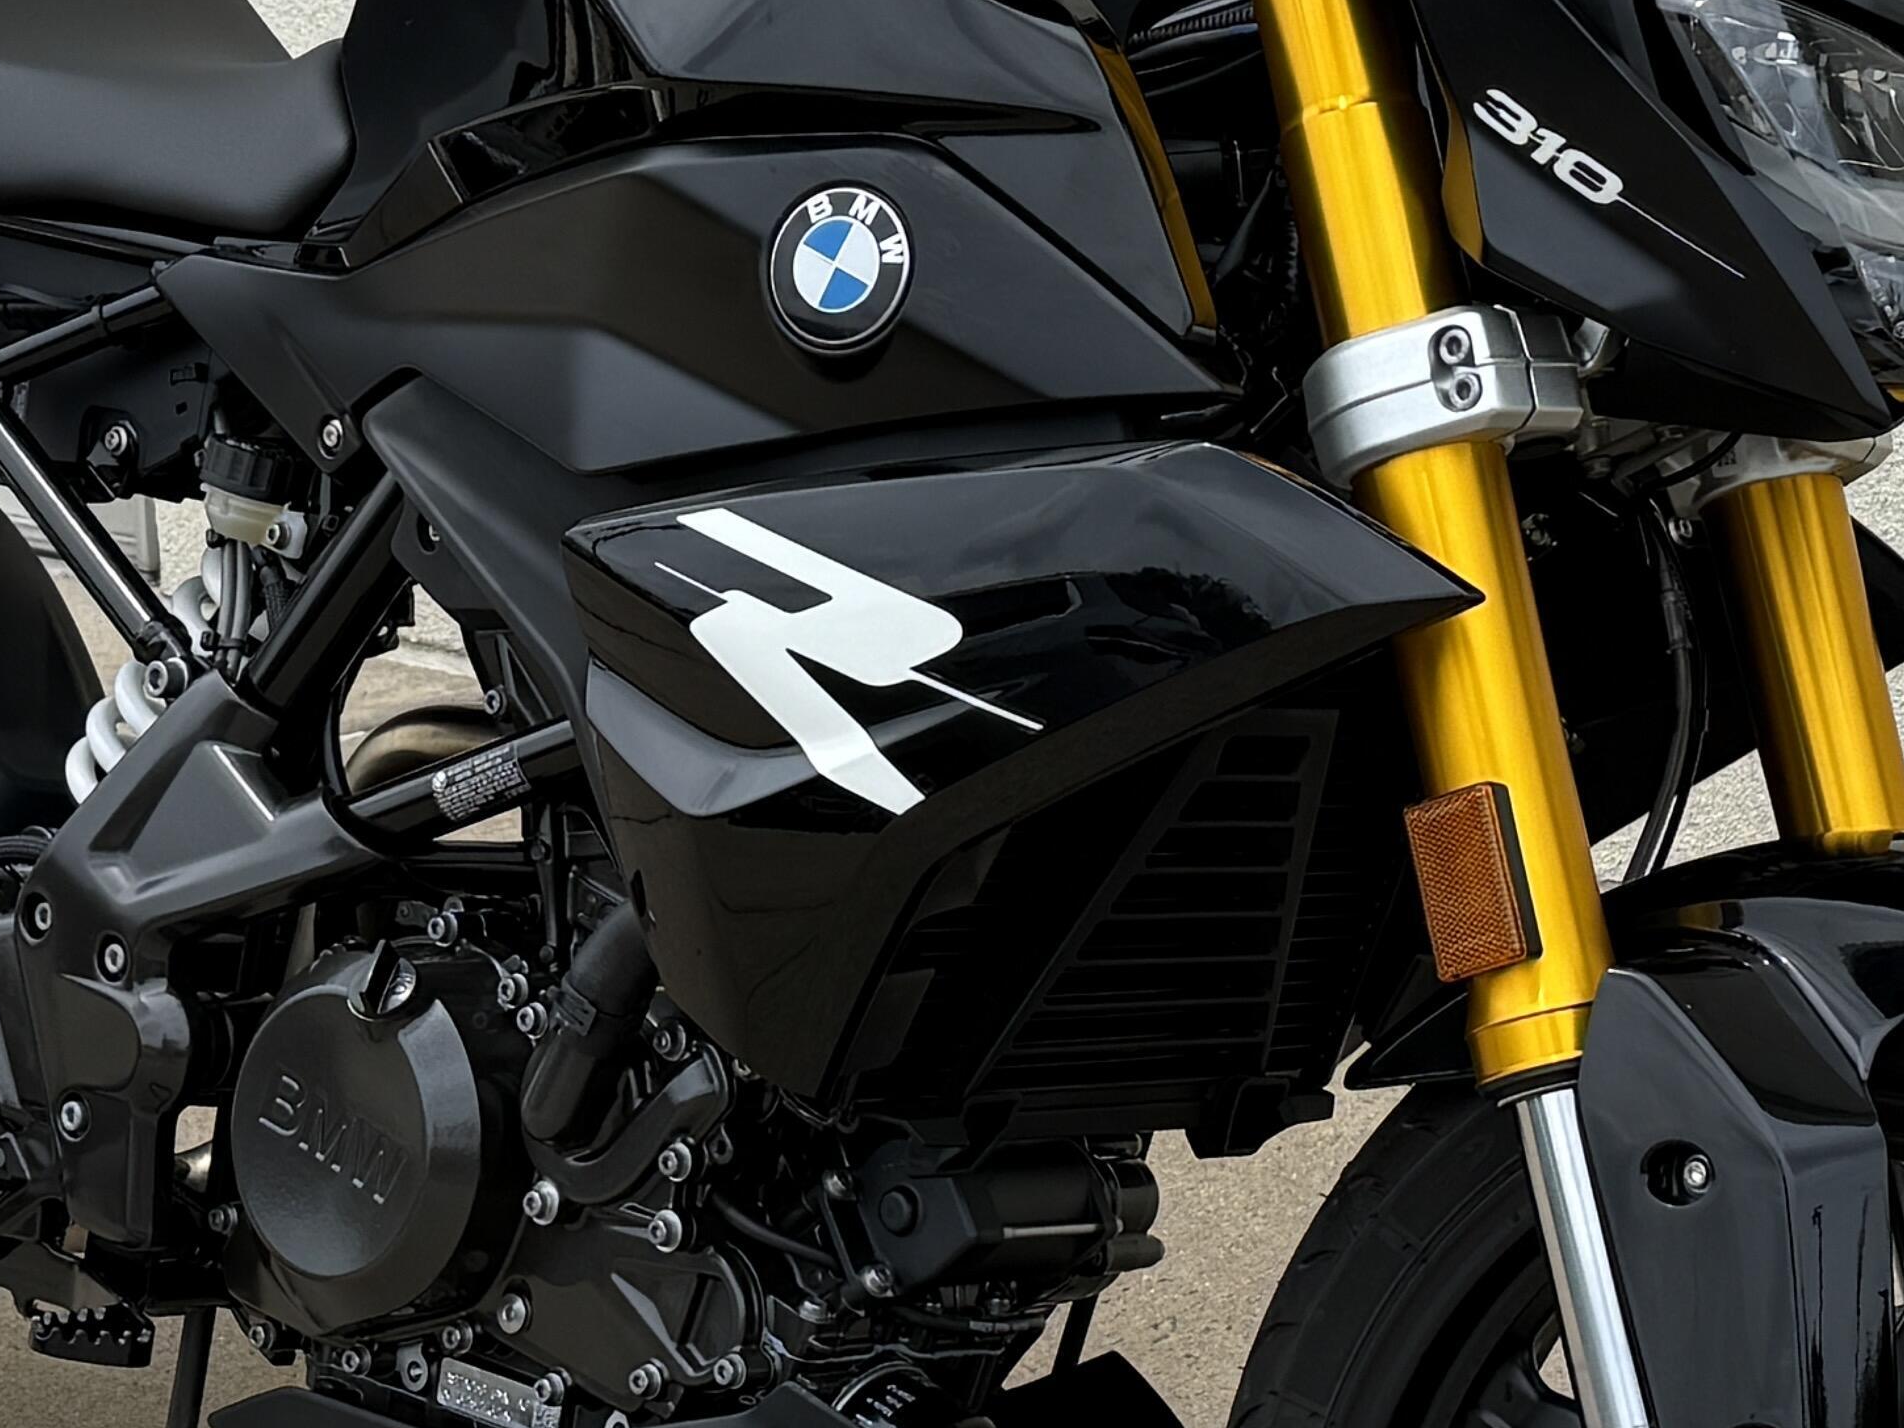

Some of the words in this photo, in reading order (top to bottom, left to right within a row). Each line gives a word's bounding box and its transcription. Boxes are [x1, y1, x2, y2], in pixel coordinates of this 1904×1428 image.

[1473, 89, 1624, 205] 310
[807, 193, 905, 264] BMW
[258, 1075, 408, 1204] BMW
